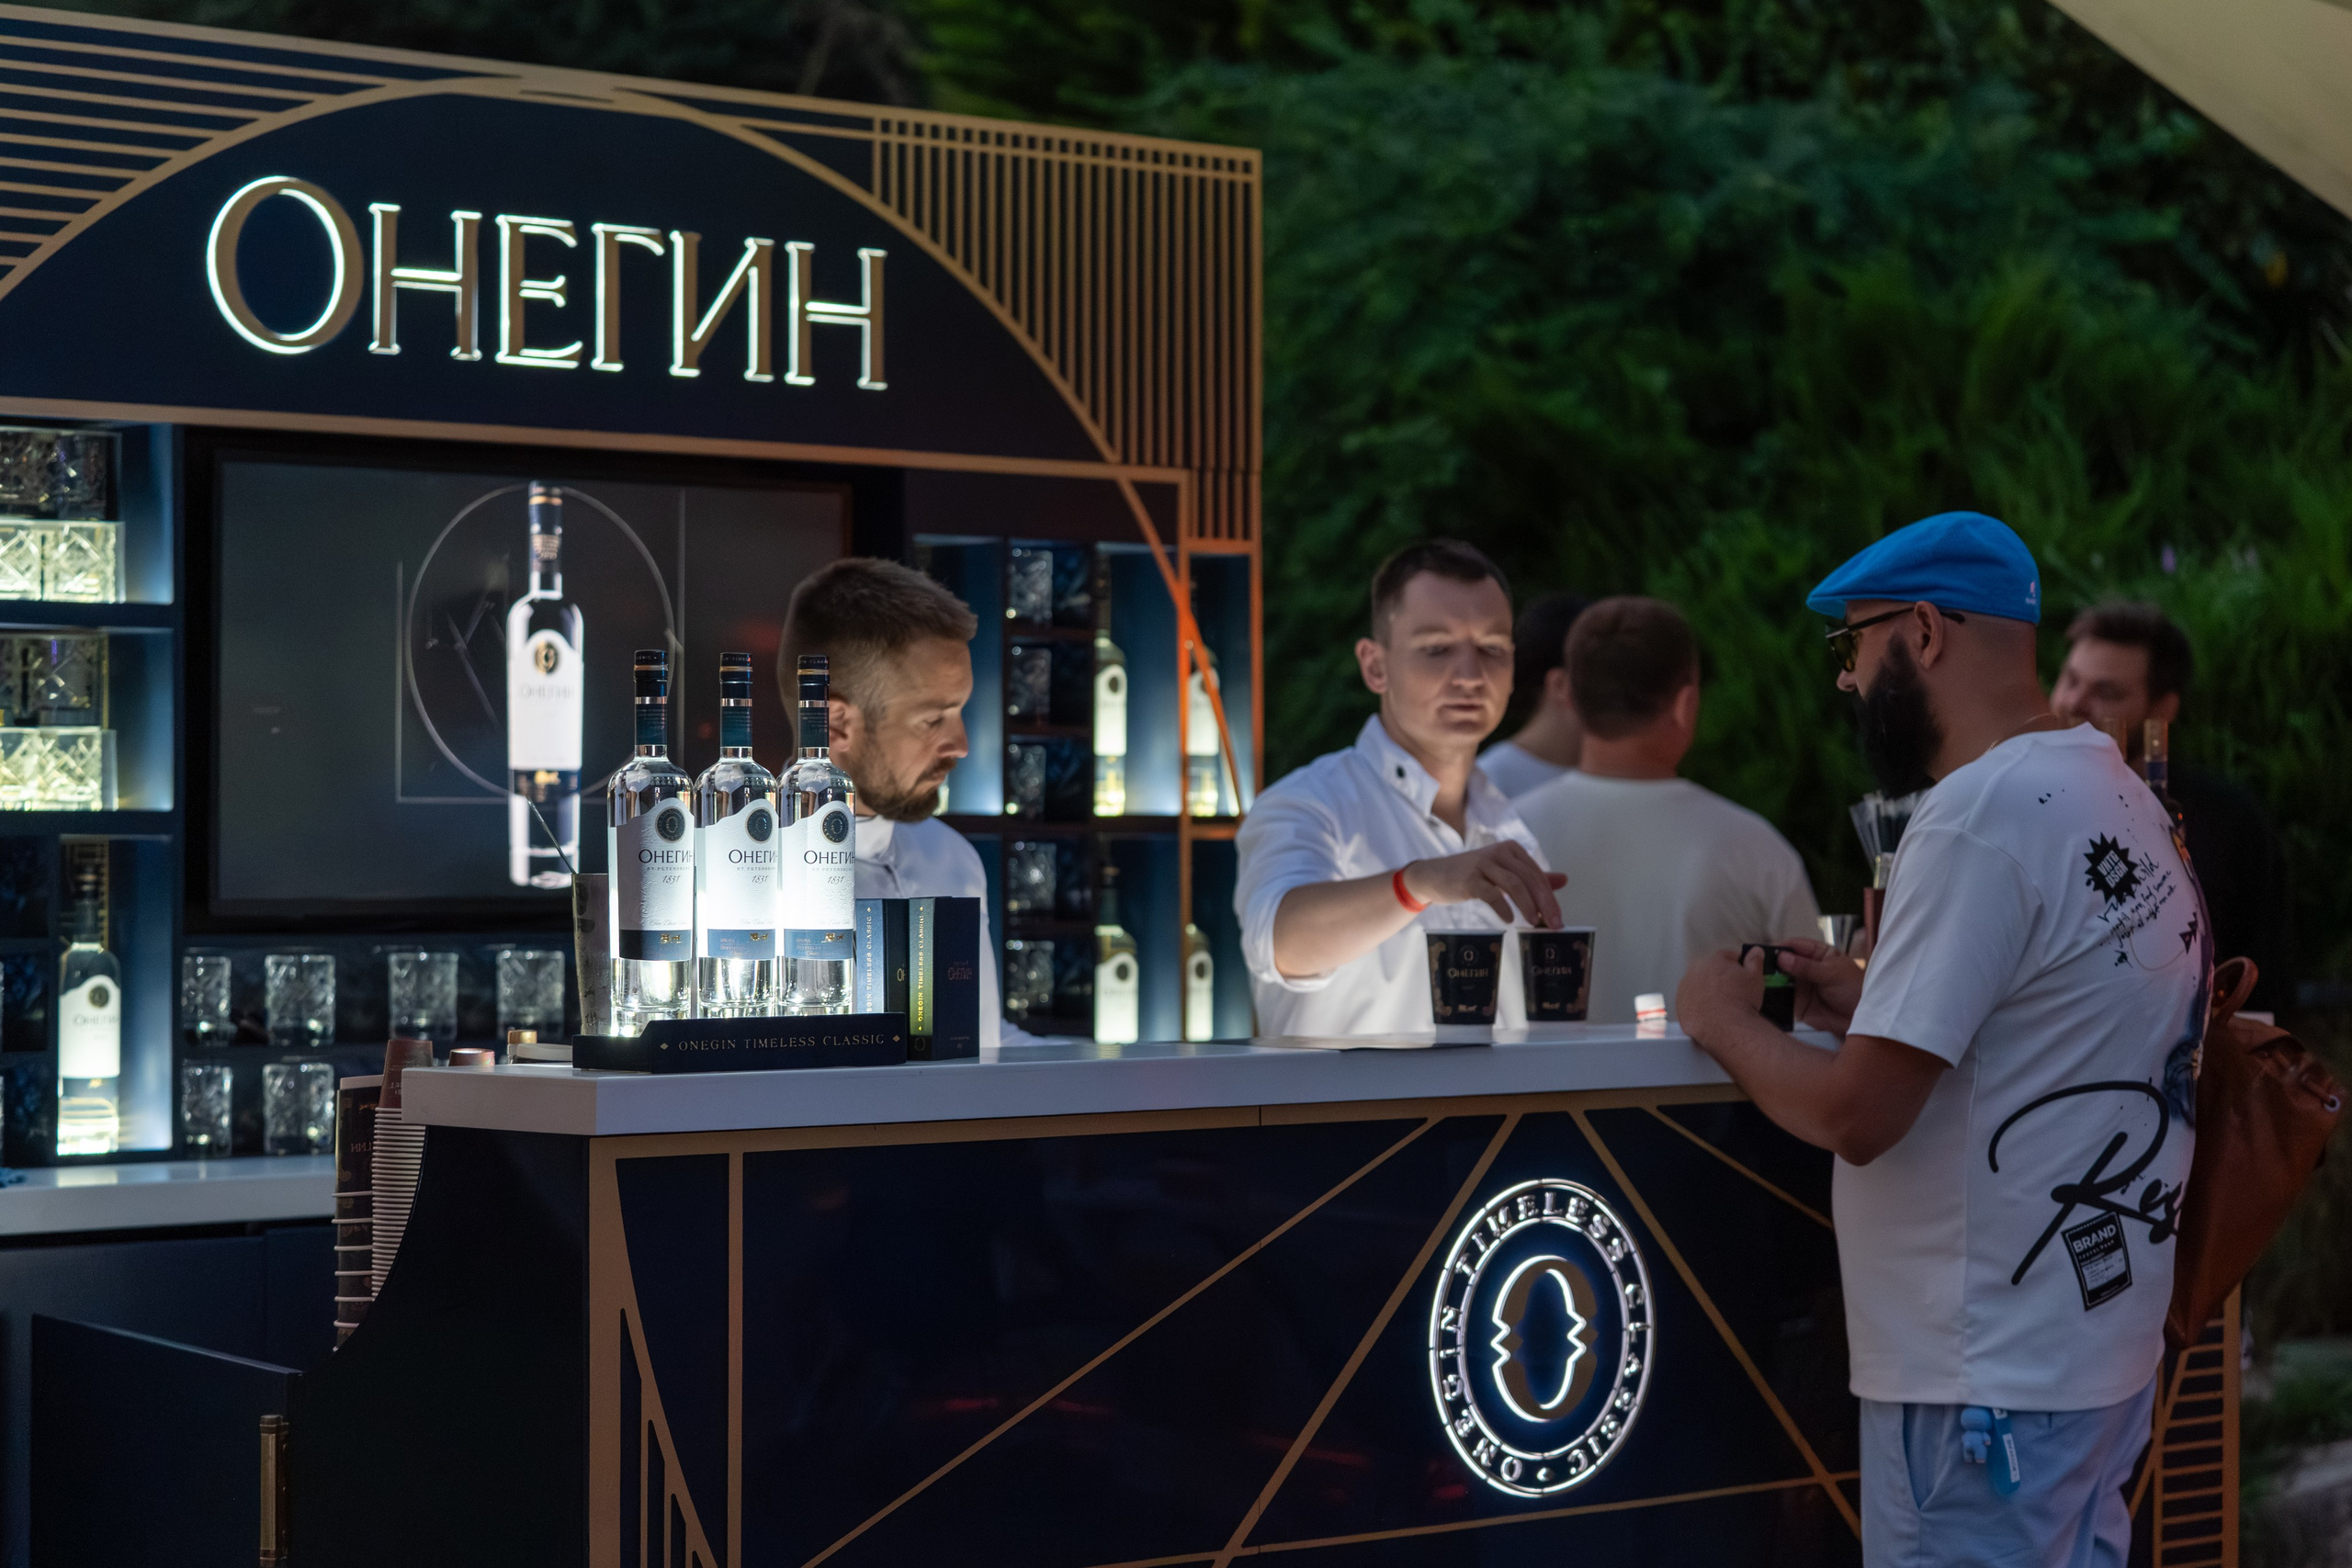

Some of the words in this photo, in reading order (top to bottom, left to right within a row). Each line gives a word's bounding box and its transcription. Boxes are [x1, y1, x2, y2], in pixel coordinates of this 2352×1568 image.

[207, 175, 888, 390] ОНЕГИН
[662, 874, 681, 885] 1831
[752, 874, 769, 885] 1831
[827, 875, 845, 886] 1831
[679, 1039, 736, 1051] ONEGIN
[743, 1036, 816, 1049] TIMELESS
[823, 1033, 885, 1046] CLASSIC
[1454, 1191, 1629, 1278] TIMELESS
[2073, 1224, 2117, 1253] BRAND
[1566, 1282, 1651, 1475] CLASSIC
[1439, 1305, 1523, 1483] ONEGIN
